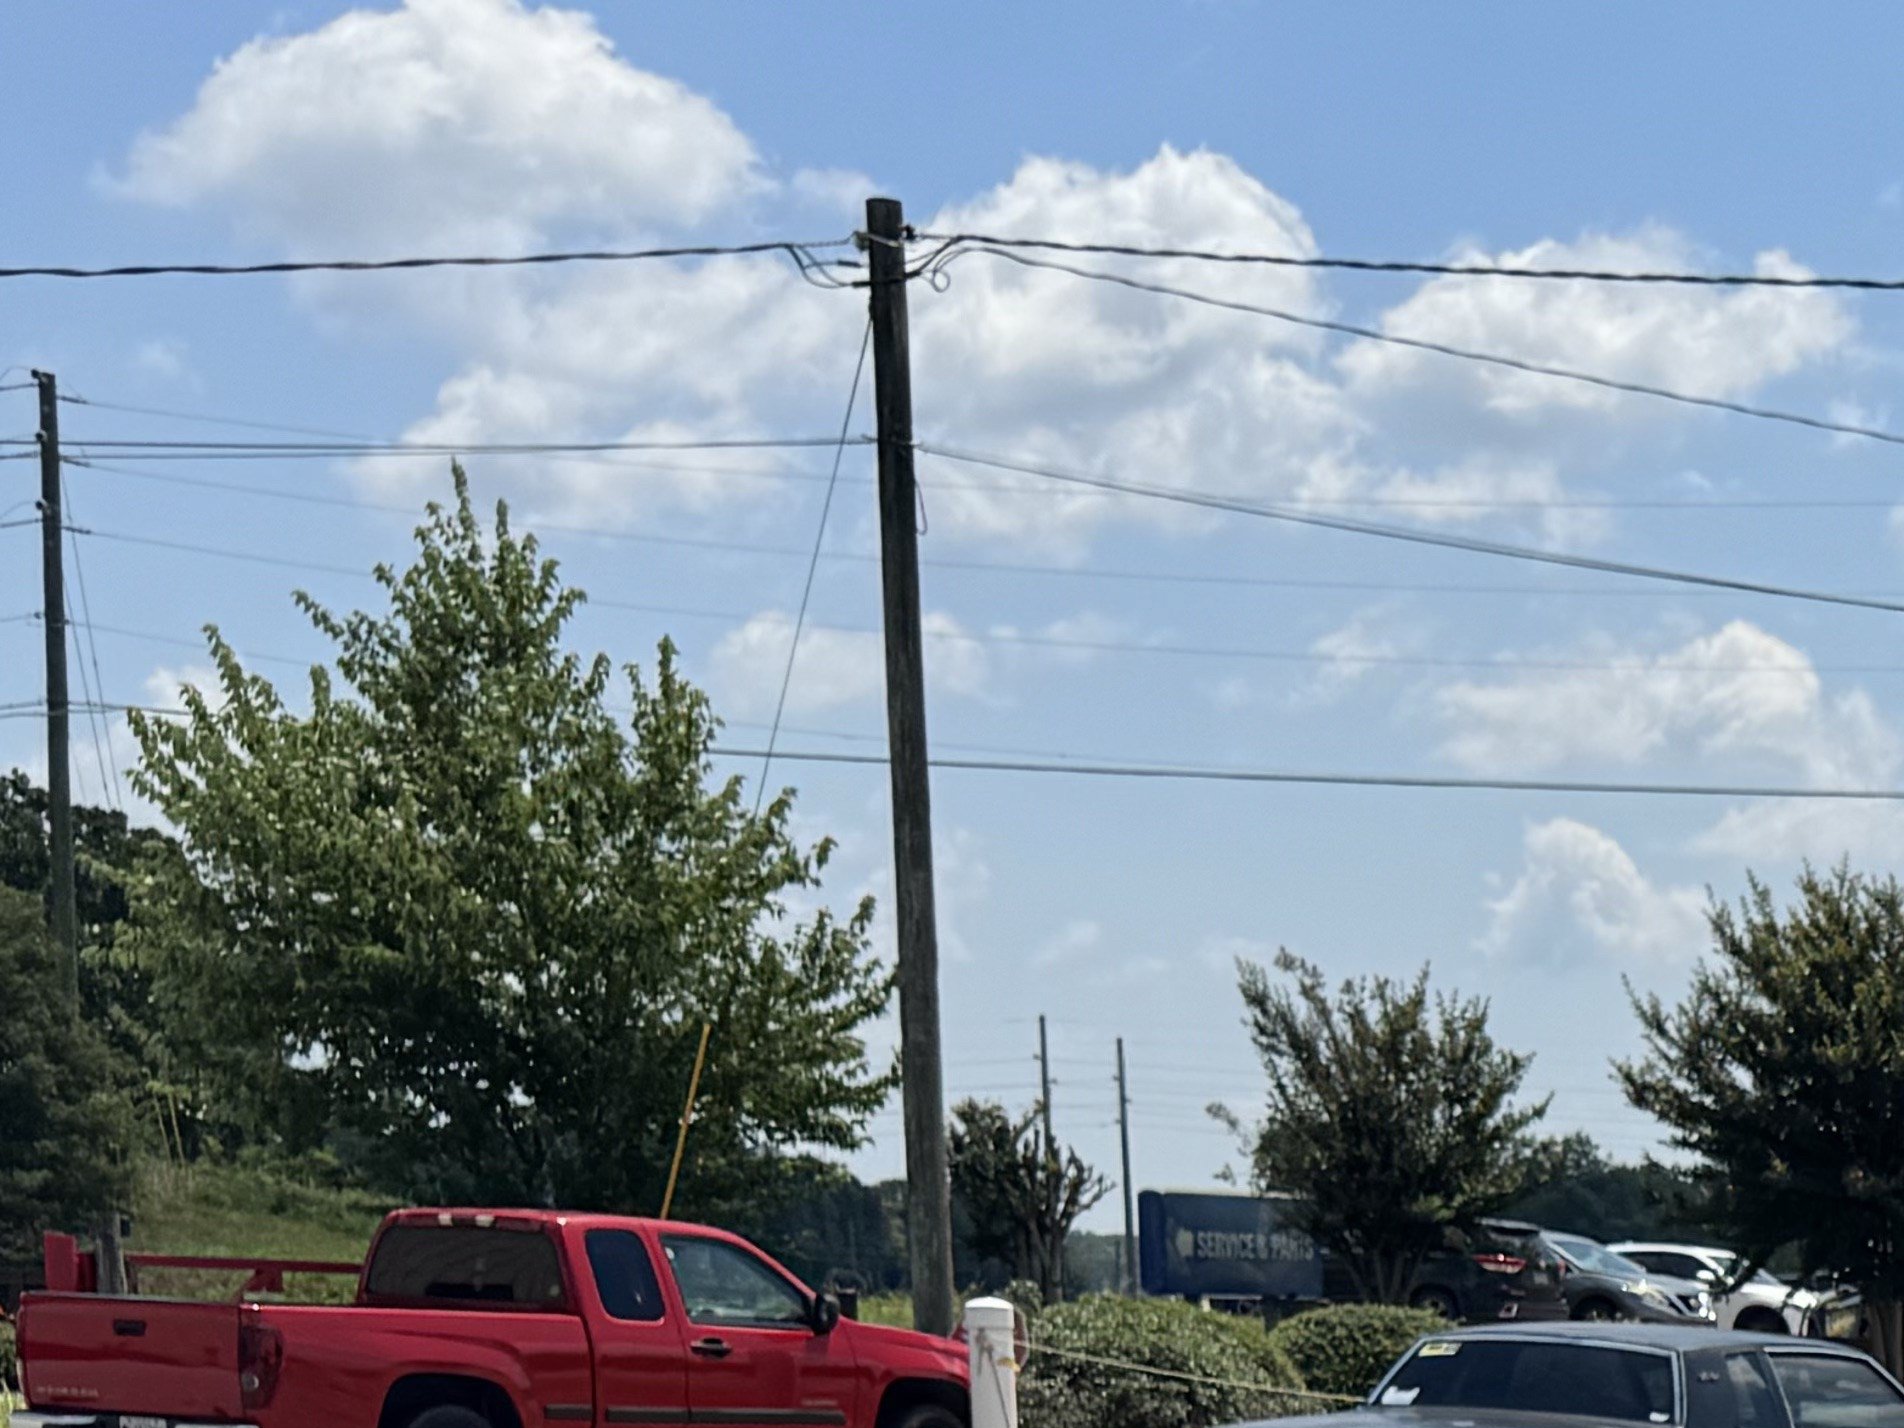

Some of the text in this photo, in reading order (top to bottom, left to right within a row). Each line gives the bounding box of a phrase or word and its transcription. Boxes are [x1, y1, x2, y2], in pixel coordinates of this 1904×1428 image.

[1197, 1230, 1315, 1260] SERVICE & PARTS
